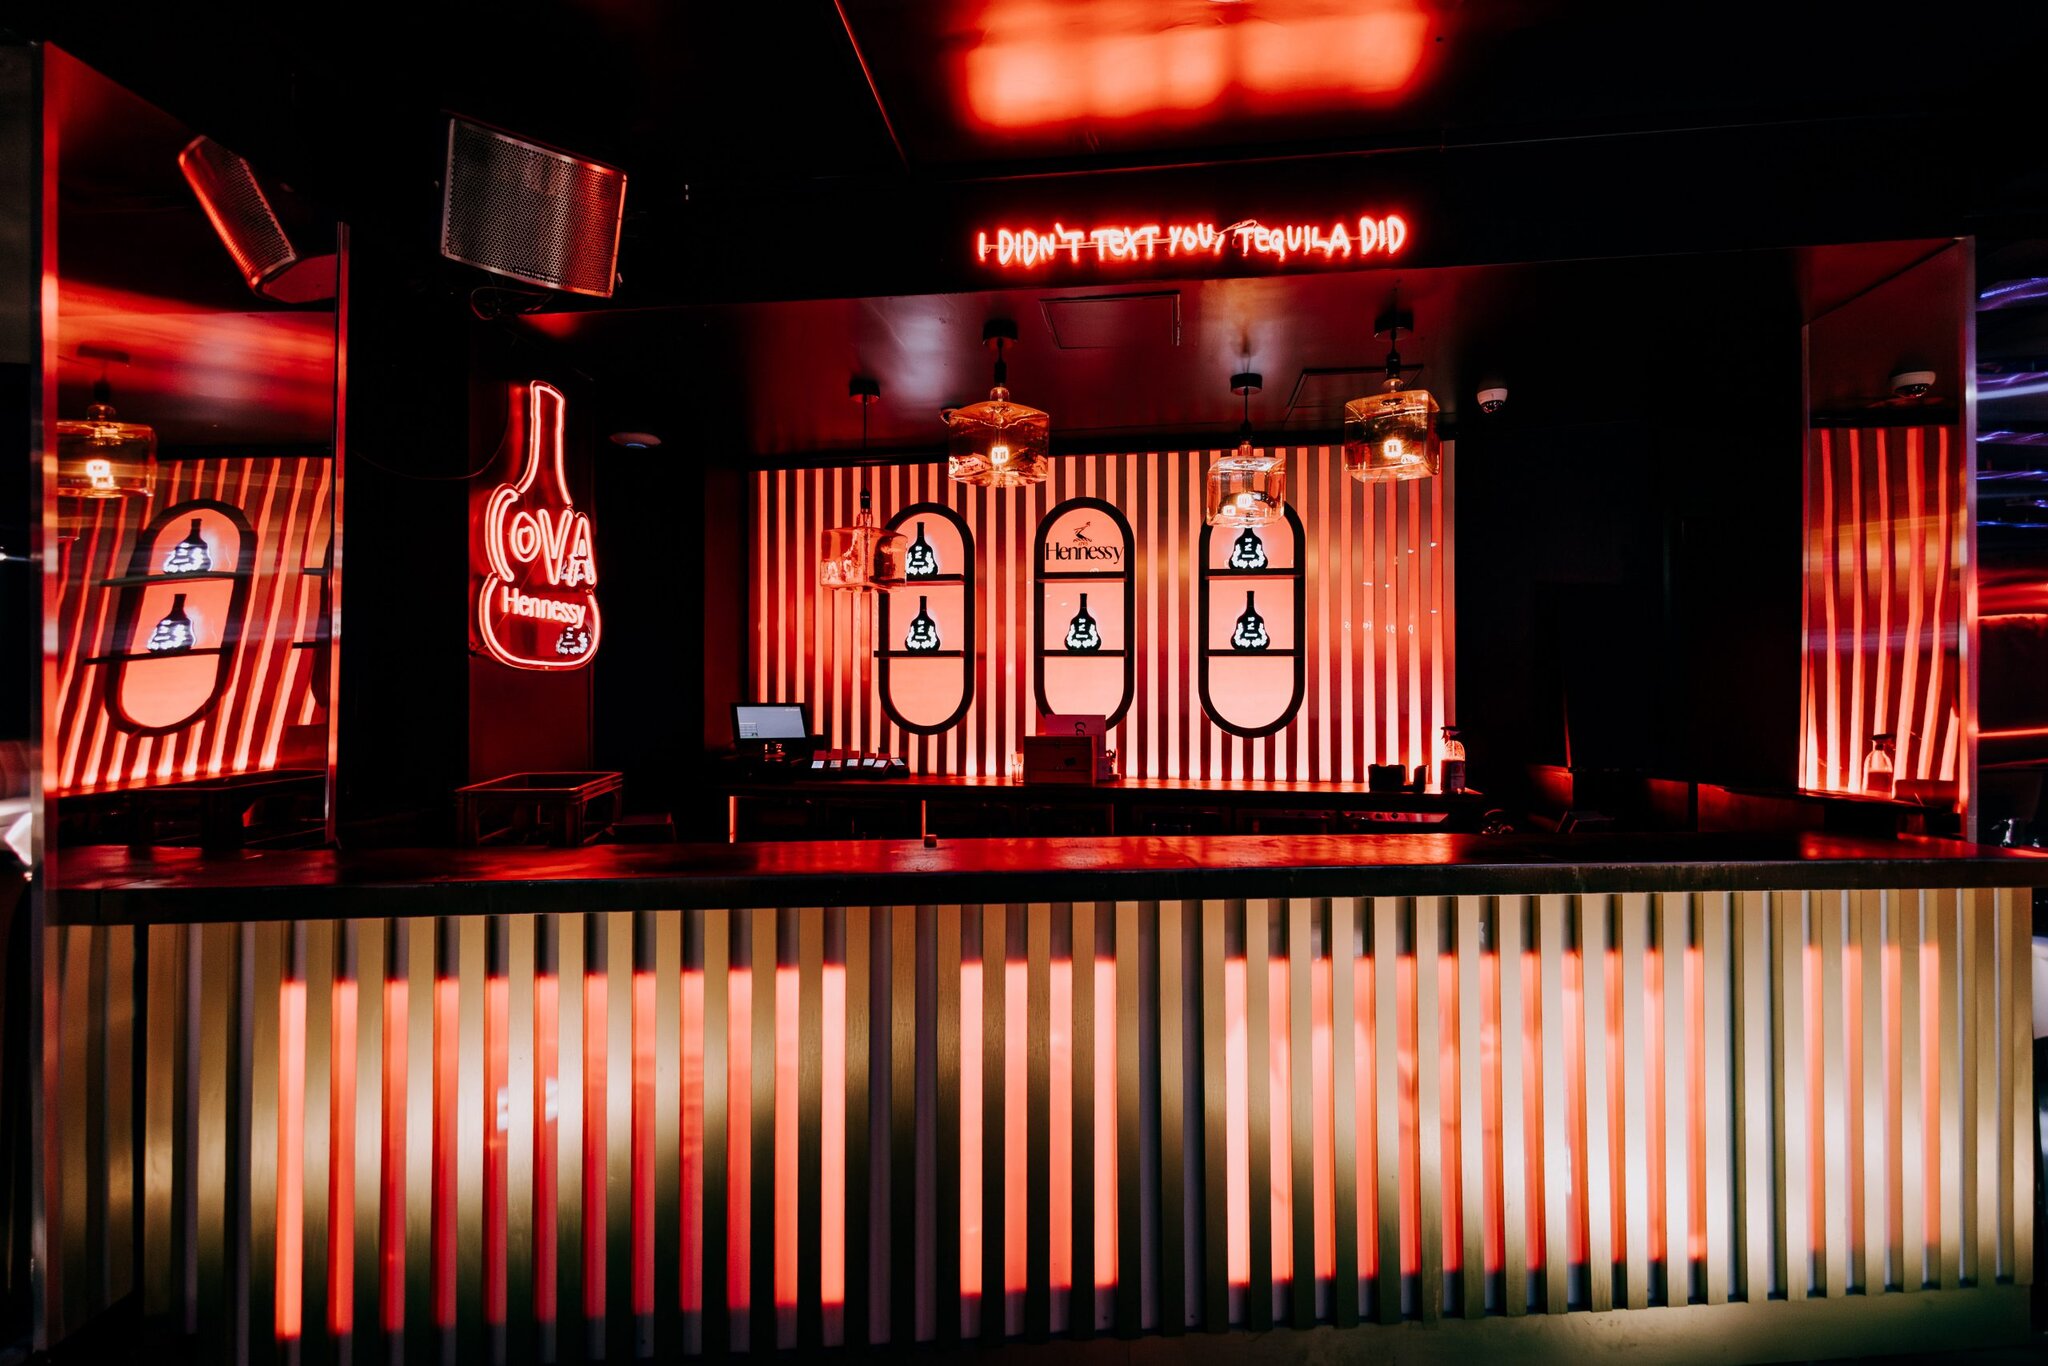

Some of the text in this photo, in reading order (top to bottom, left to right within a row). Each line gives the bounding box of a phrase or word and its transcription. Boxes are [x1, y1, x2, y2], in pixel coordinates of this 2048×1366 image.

[978, 231, 986, 261] I
[999, 223, 1084, 267] DIDN'T
[1091, 226, 1160, 260] TEXT
[1235, 222, 1351, 262] TEQUILA
[1360, 215, 1405, 255] DID
[487, 486, 596, 587] COVA
[1046, 541, 1124, 565] Hennessy
[501, 586, 586, 628] Hennessy
